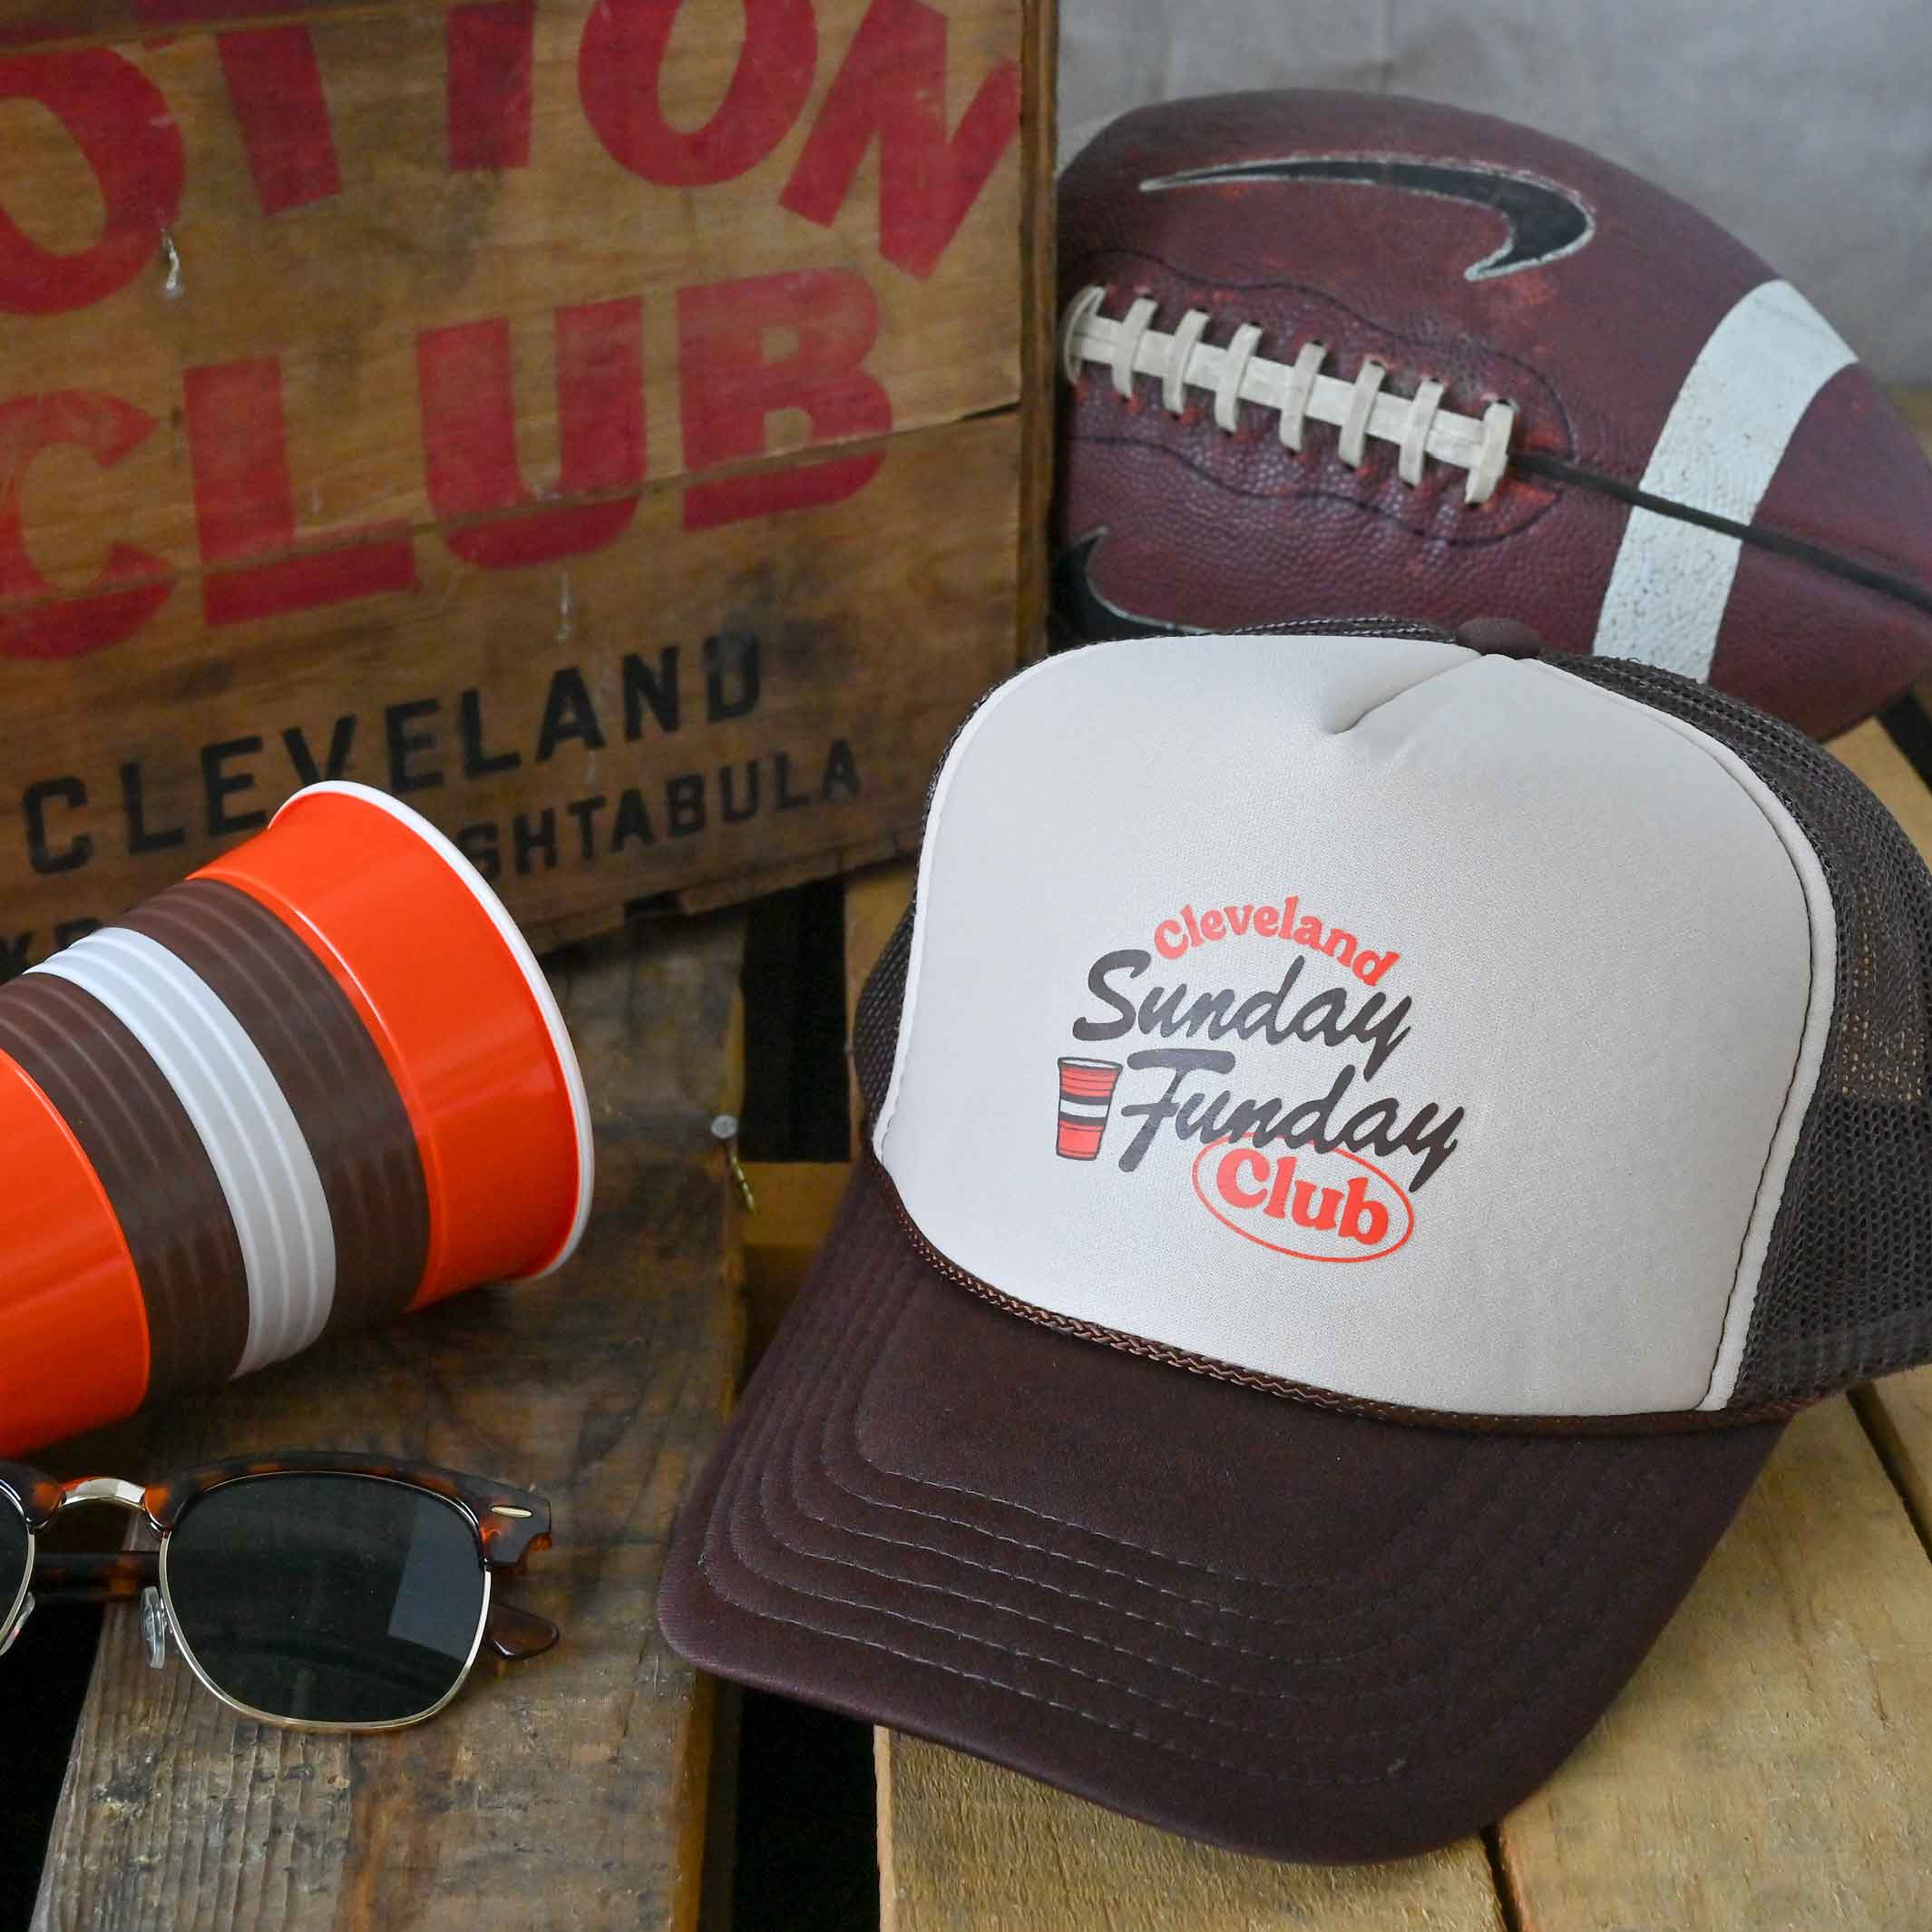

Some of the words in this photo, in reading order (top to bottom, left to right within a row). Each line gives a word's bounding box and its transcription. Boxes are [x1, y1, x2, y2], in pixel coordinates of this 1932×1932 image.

[0, 268, 893, 662] CLUB
[22, 630, 762, 876] CLEVELAND
[1153, 894, 1400, 987] Cleveland
[1072, 948, 1413, 1082] Sunday
[1117, 1048, 1465, 1194] Funday
[1215, 1147, 1390, 1245] Club
